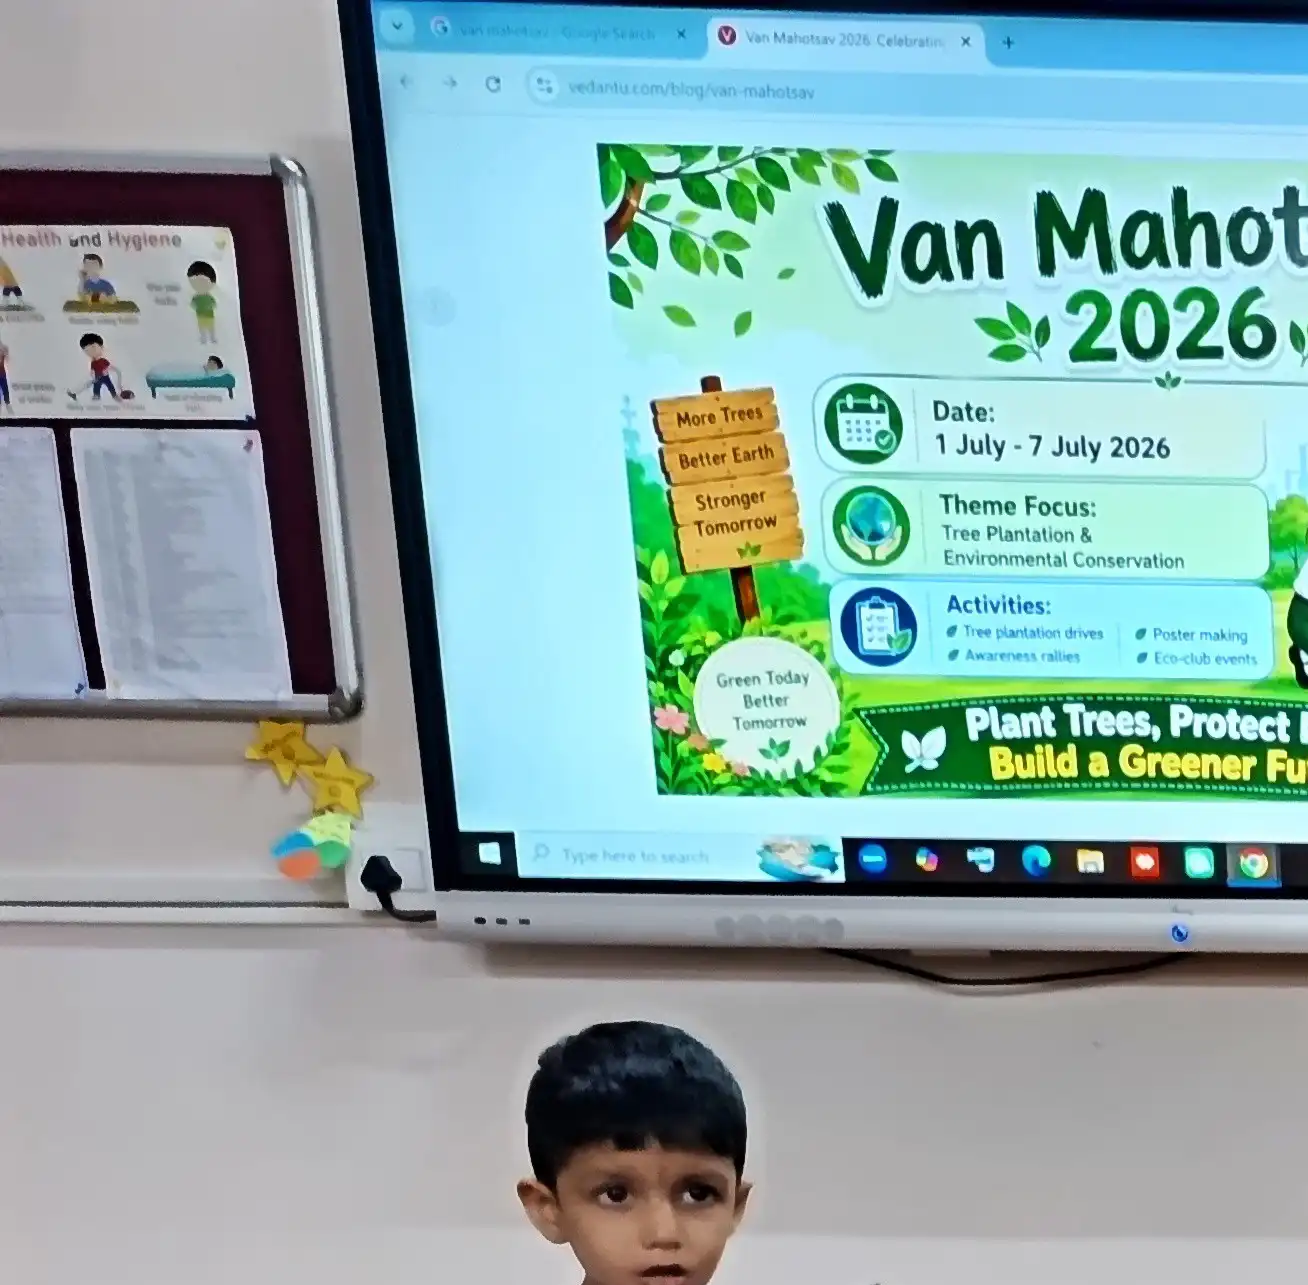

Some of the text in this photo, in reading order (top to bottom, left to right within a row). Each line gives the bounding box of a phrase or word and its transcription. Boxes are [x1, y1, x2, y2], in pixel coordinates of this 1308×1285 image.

[746, 30, 770, 44] Van
[773, 31, 836, 46] Mahotsav
[876, 34, 948, 50] Celebratin
[0, 229, 62, 248] Health
[108, 230, 182, 251] Hygiene
[824, 195, 1004, 300] Van
[1065, 286, 1278, 364] 2026
[676, 406, 763, 429] More Trees
[933, 401, 995, 423] Date:
[679, 445, 774, 471] Better Earth
[935, 434, 946, 455] 1
[956, 435, 1005, 462] July
[1029, 436, 1042, 457] 7
[1052, 436, 1102, 463] July
[1110, 436, 1171, 460] 2026
[695, 489, 767, 512] Stronger
[939, 494, 1097, 518] Theme Focus:
[694, 513, 778, 539] Tomorrow
[942, 525, 1092, 544] Tree Plantation &
[944, 549, 1185, 570] Environmental Conservation
[947, 595, 1051, 616] Activities:
[963, 624, 1104, 642] Tree plantation drives
[1153, 628, 1248, 645] Poster making
[965, 649, 1081, 664] Awareness rallies
[1154, 652, 1257, 667] Eco-club events
[717, 671, 809, 688] Green Today
[743, 694, 790, 709] Better
[733, 716, 807, 731] Tomorrow
[966, 707, 1056, 743] Plant
[1064, 705, 1161, 744] Trees,
[1170, 704, 1291, 741] Protect
[989, 744, 1078, 782] Build
[1088, 752, 1108, 776] a
[1119, 744, 1257, 780] Greener
[563, 849, 710, 866] Type here to search
